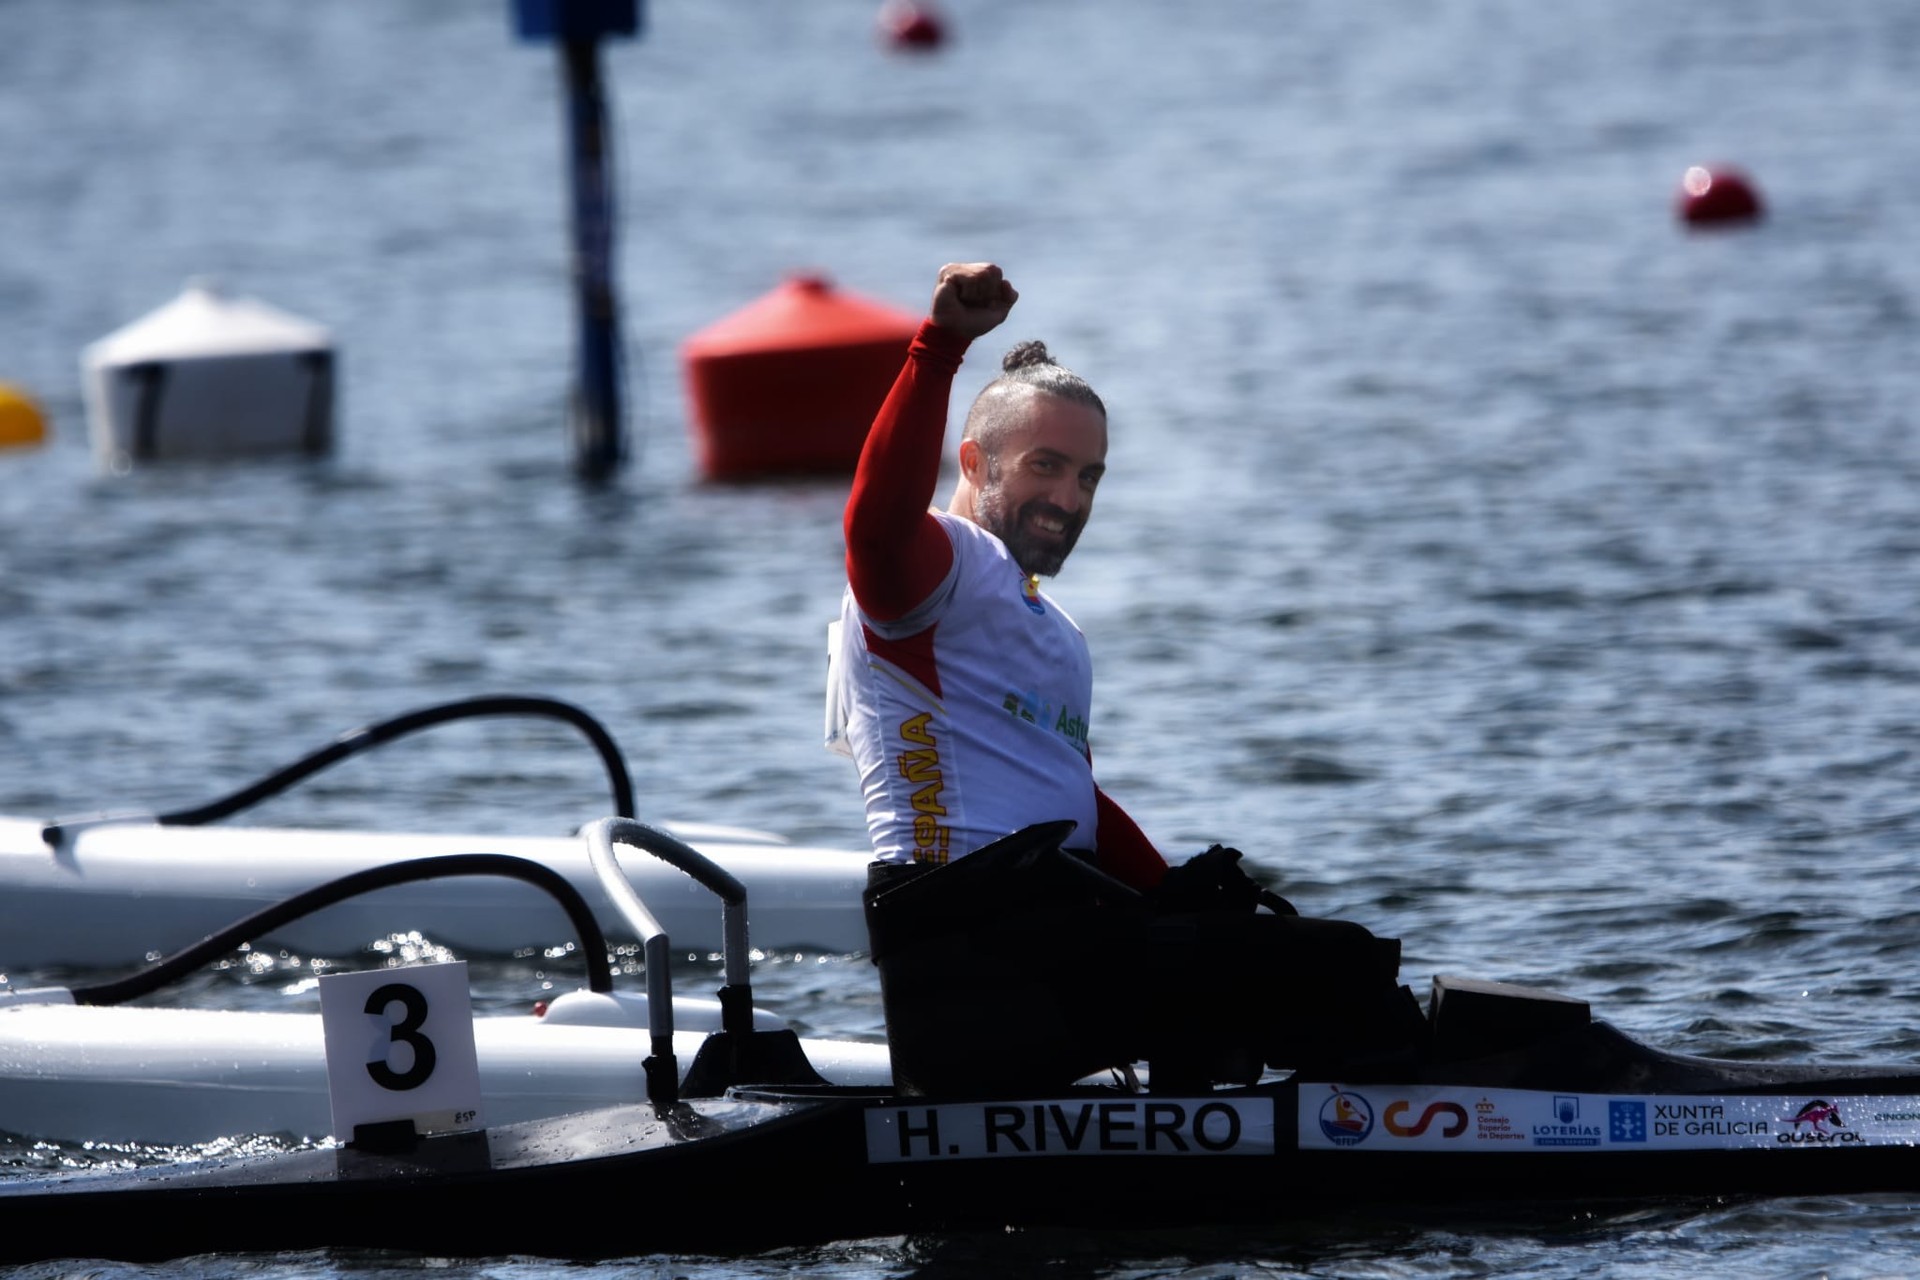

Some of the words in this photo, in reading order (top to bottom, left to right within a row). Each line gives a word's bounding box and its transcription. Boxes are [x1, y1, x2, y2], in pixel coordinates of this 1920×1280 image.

[364, 983, 436, 1091] 3
[454, 1110, 476, 1124] ESP
[1654, 1105, 1724, 1120] XUNTA
[1477, 1116, 1509, 1126] Consejo
[898, 1109, 960, 1157] H.
[985, 1102, 1242, 1153] RIVERO
[1533, 1124, 1601, 1136] LOTERÍAS
[1654, 1121, 1679, 1135] DE
[1685, 1121, 1768, 1136] GALICIA
[1489, 1132, 1525, 1140] Deportes
